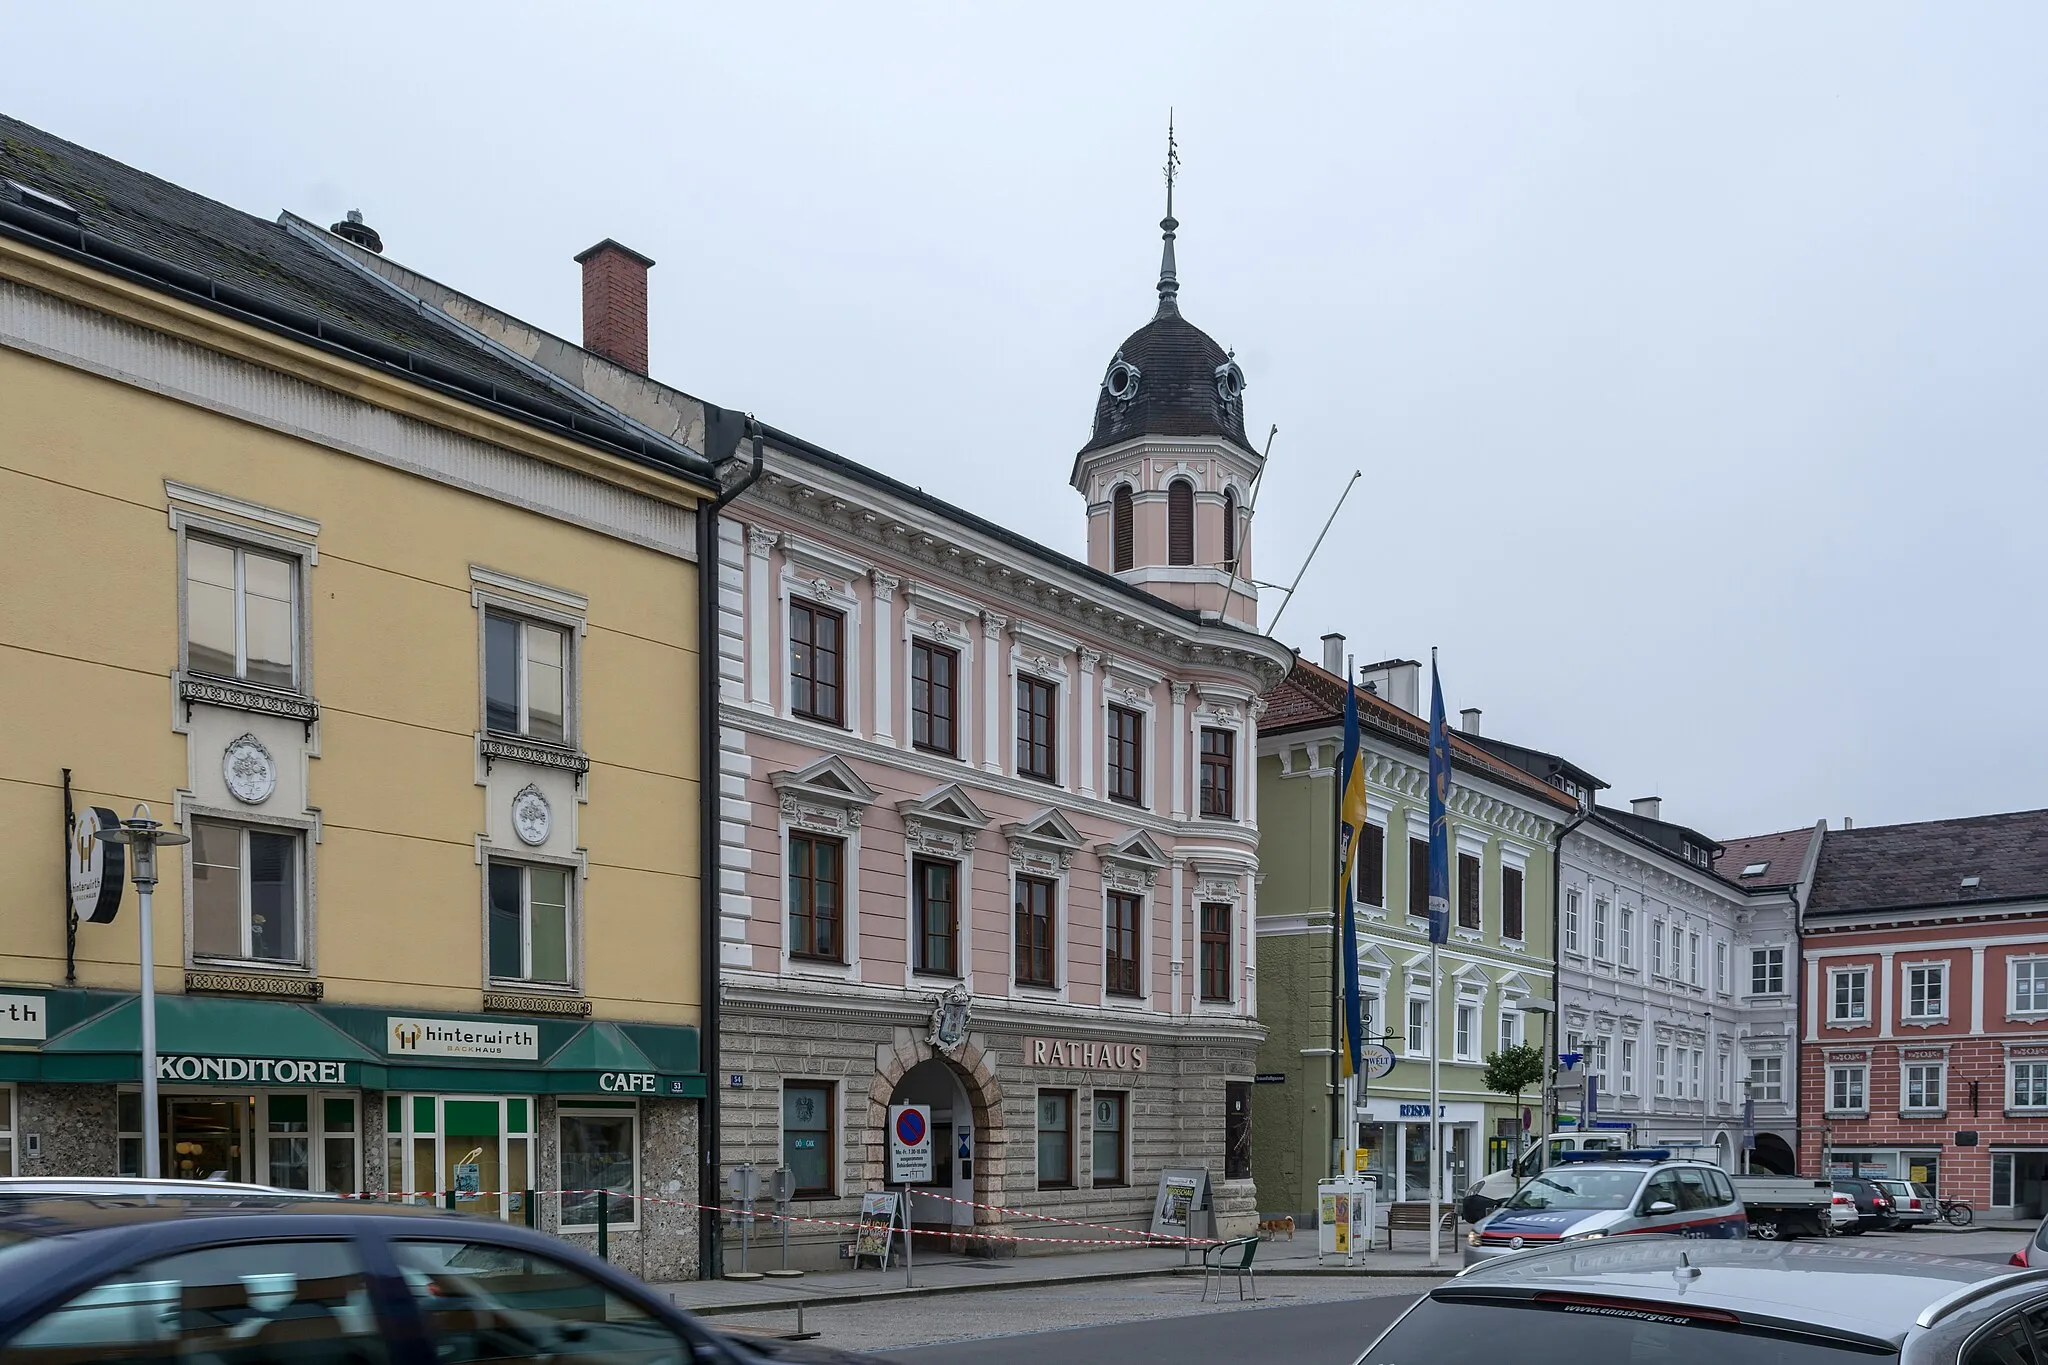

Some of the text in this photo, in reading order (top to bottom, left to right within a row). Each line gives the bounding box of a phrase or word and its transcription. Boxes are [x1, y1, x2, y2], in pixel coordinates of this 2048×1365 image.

[426, 1026, 533, 1046] hinterwirth
[447, 1045, 502, 1054] BACKHAUS
[1033, 1039, 1144, 1070] RATHAUS
[155, 1056, 346, 1084] KONDITOREI
[599, 1072, 656, 1092] CAFE
[673, 1082, 681, 1090] 53
[1400, 1104, 1446, 1118] REISEWT
[1505, 1213, 1565, 1223] POLIZEI
[1564, 1304, 1690, 1324] www.ennsberger.at
